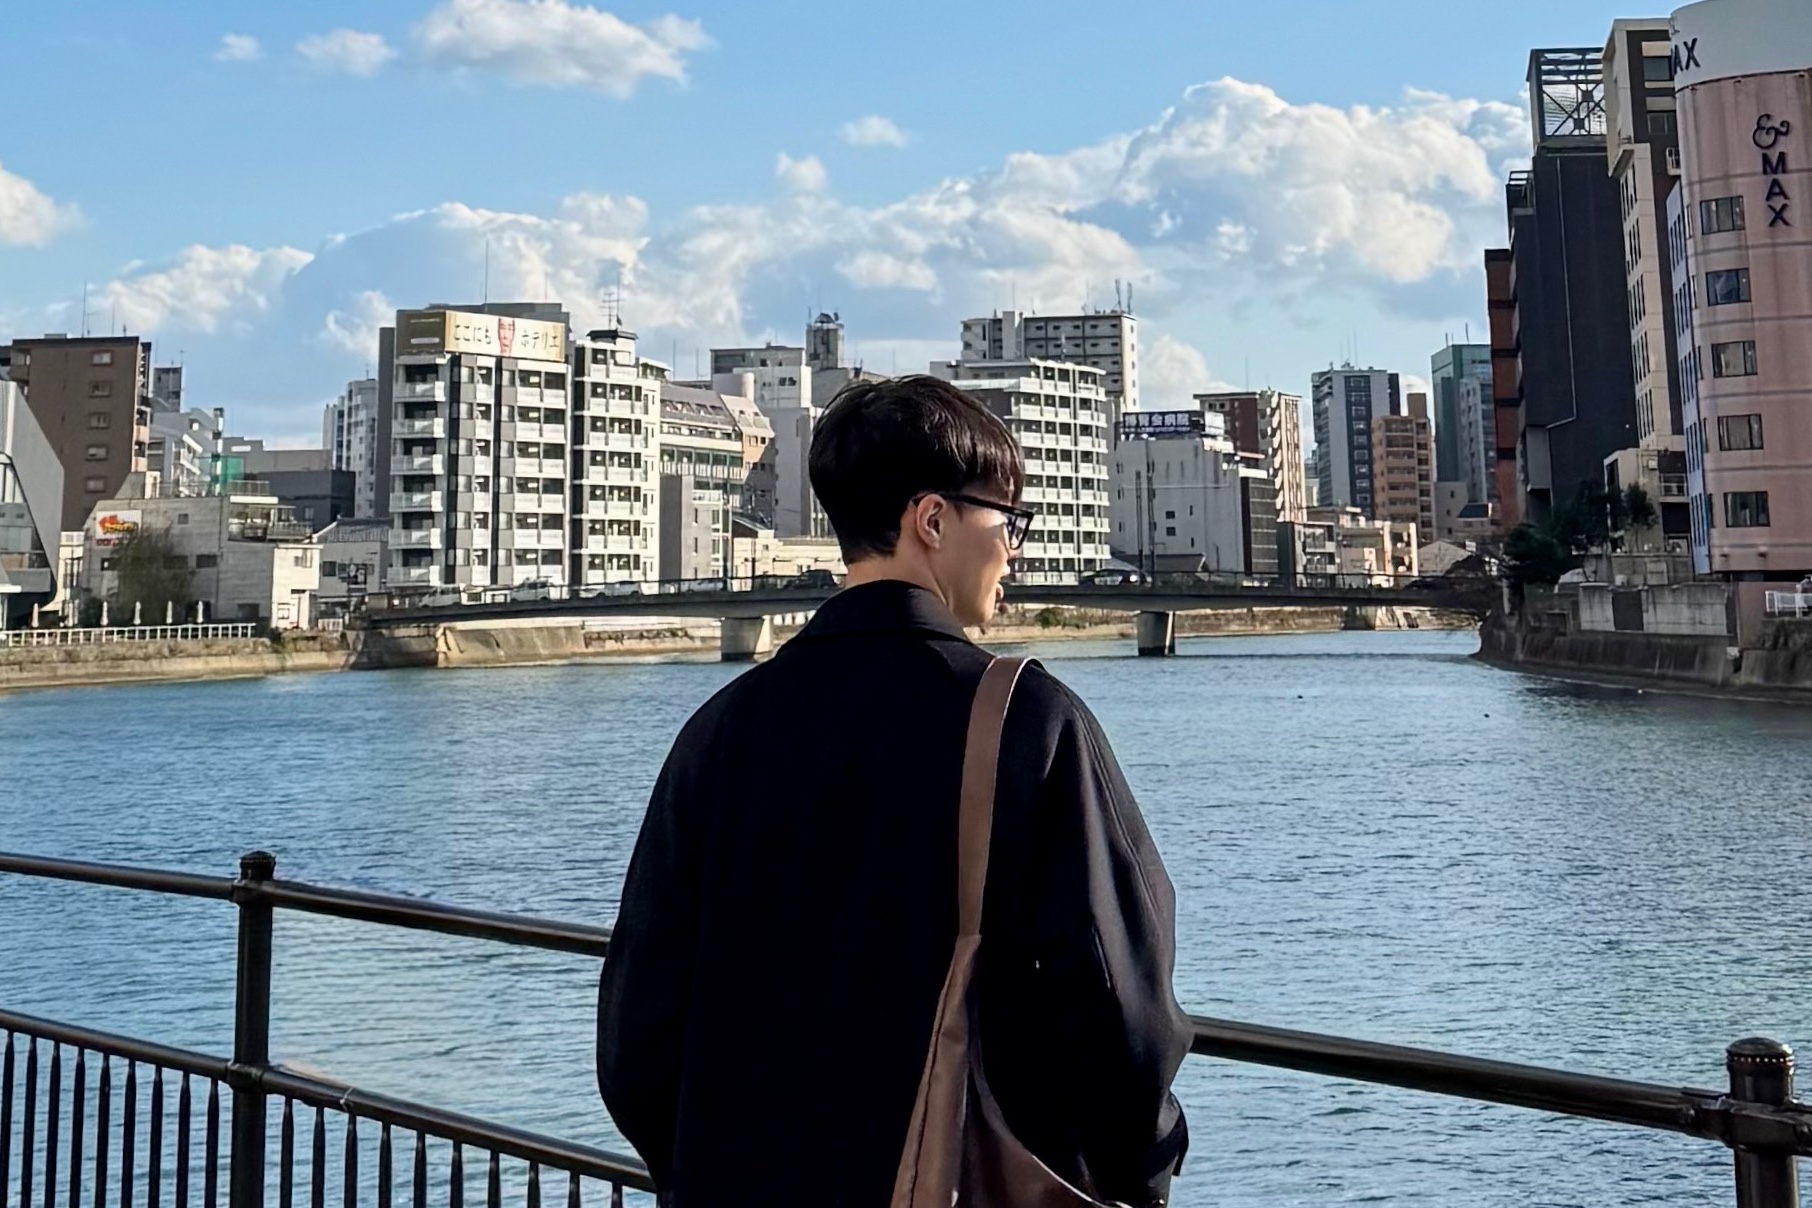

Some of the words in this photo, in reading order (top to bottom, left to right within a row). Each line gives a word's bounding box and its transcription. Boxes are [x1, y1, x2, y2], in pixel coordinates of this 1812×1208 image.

[1670, 38, 1700, 75] AX
[1762, 151, 1791, 228] MAX
[454, 324, 492, 345] ここにも
